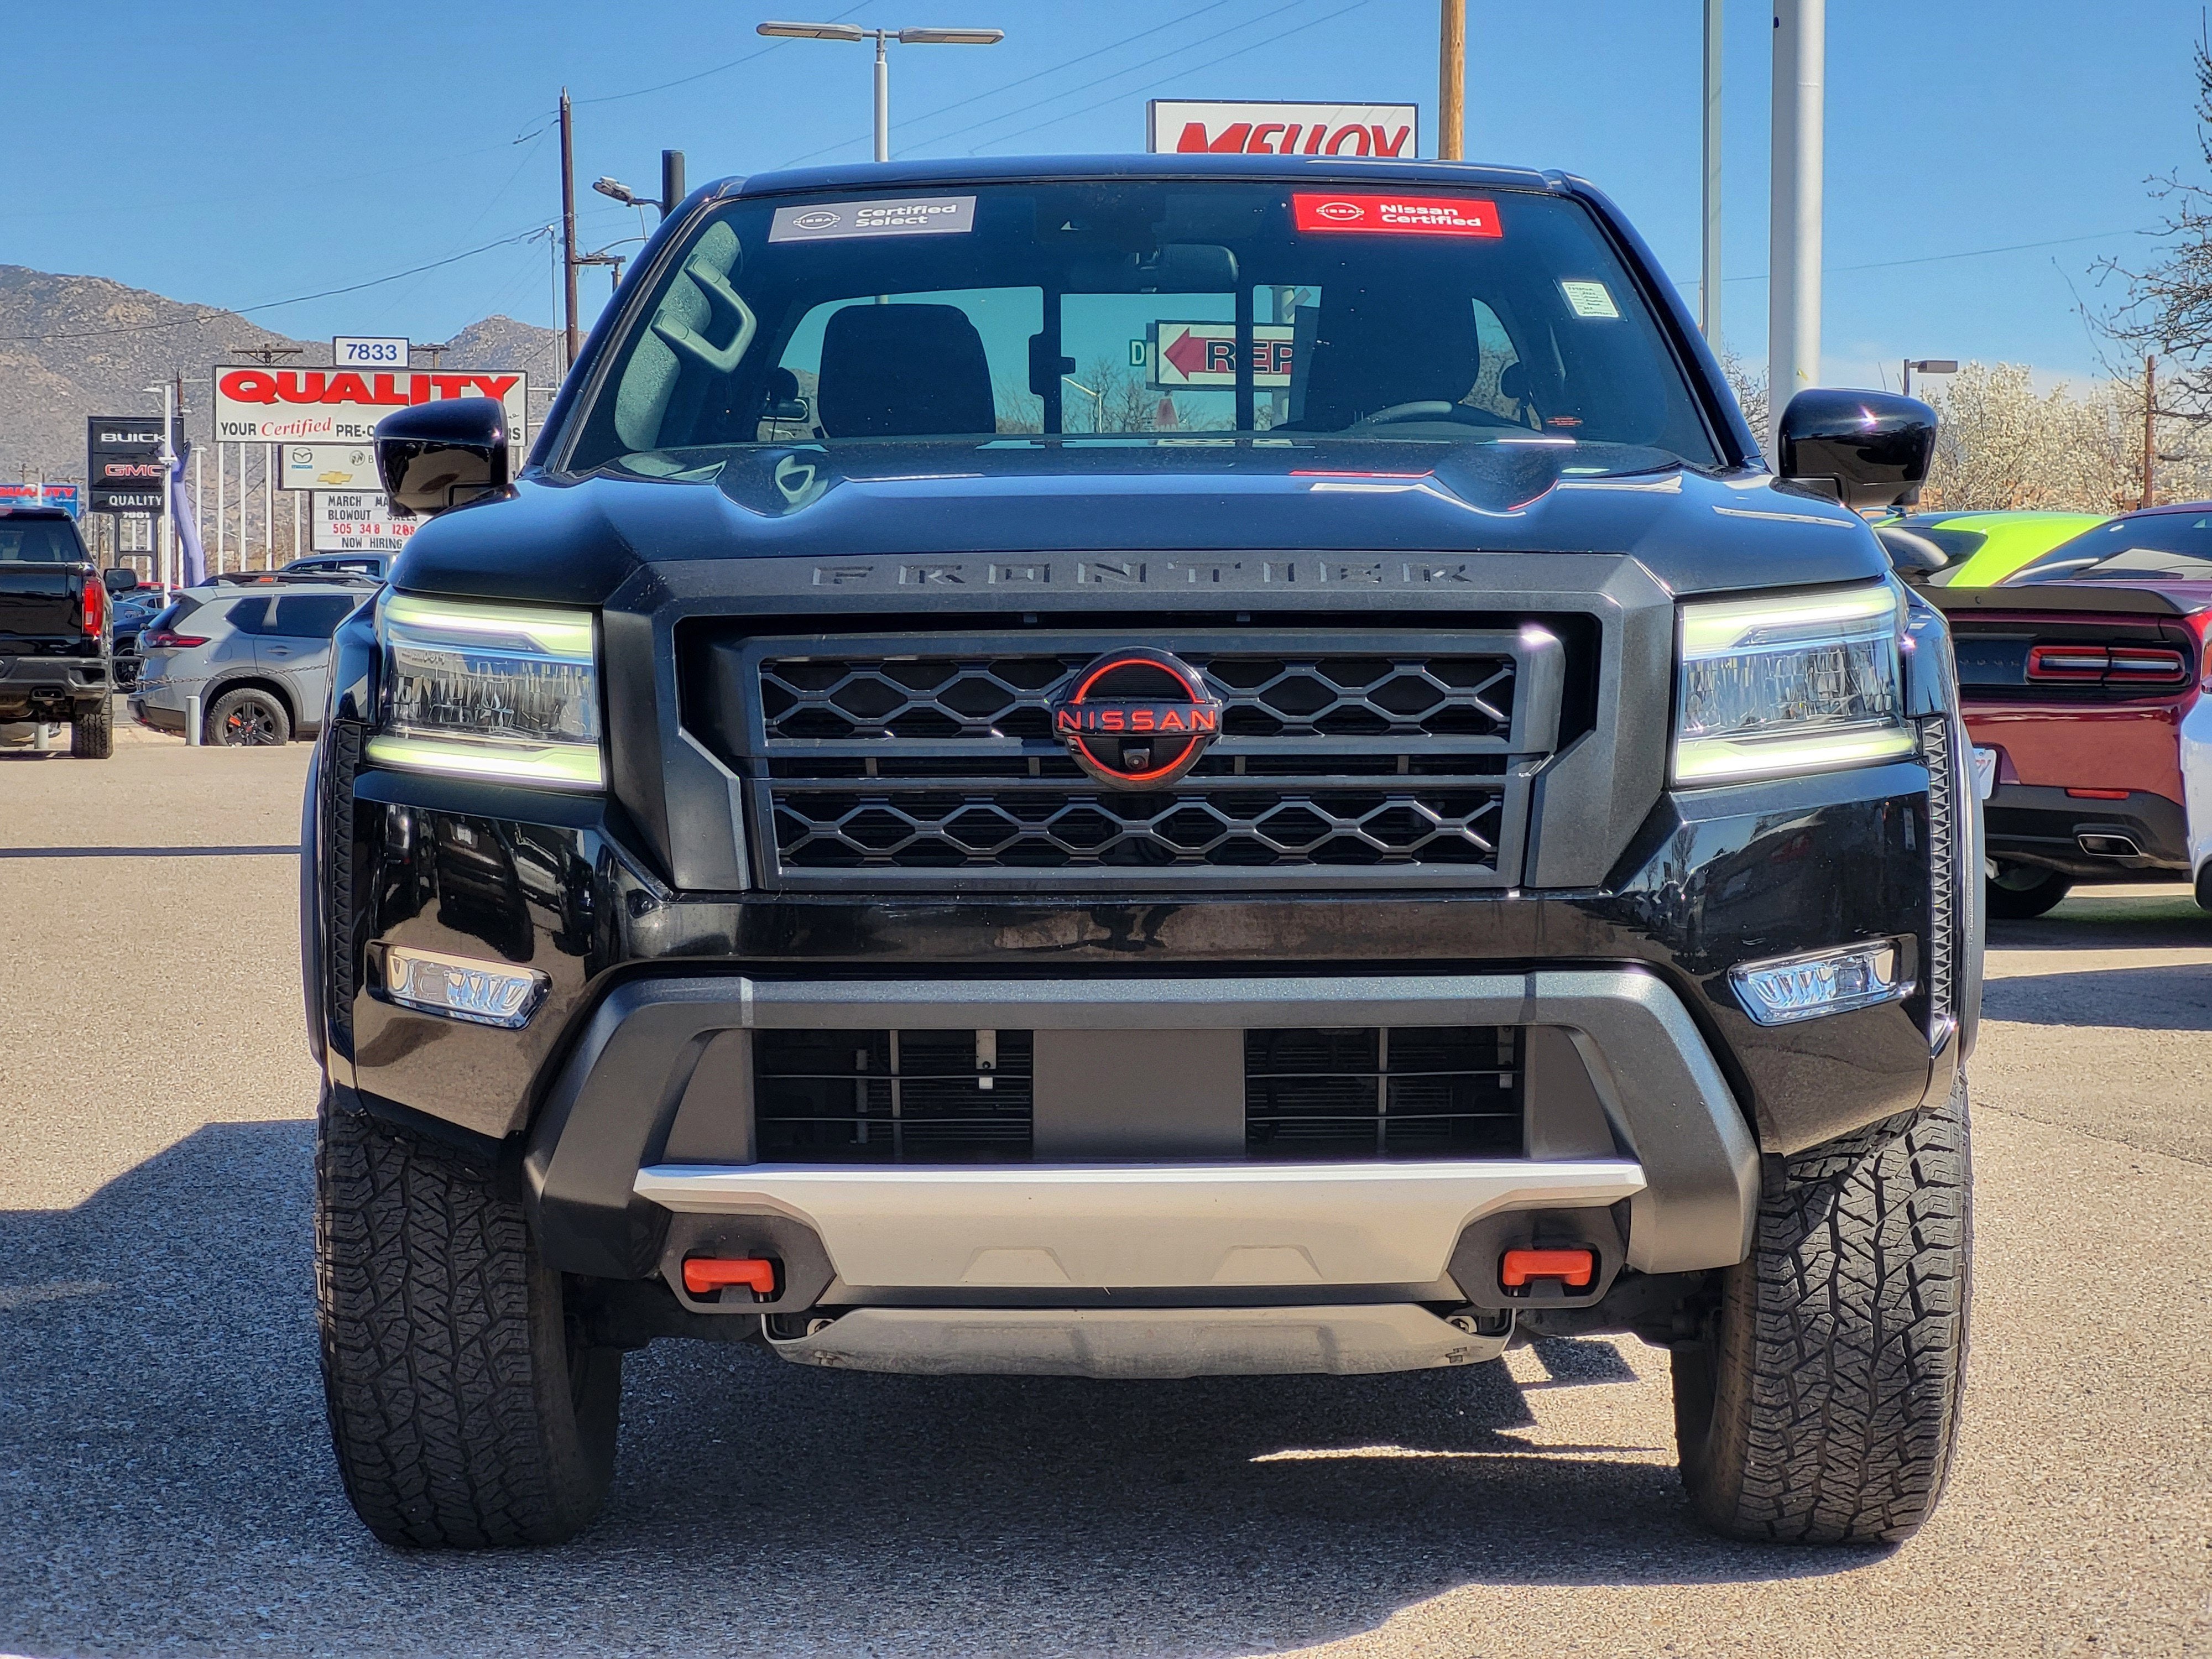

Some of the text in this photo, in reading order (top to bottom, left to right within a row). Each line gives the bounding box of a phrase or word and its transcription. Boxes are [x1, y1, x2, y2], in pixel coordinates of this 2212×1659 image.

[858, 205, 957, 217] Certified
[1380, 204, 1458, 216] Nissan
[855, 216, 929, 227] Select
[1381, 214, 1481, 227] Certified
[346, 343, 397, 360] 7833
[219, 369, 520, 406] QUALITY
[220, 422, 257, 436] YOUR
[262, 417, 332, 437] Certified
[101, 433, 165, 442] BUICK
[105, 464, 165, 477] GMC
[109, 495, 162, 505] QUALITY
[328, 495, 362, 507] MARCH
[328, 509, 372, 521] BLOWOUT
[333, 523, 352, 534] 505
[342, 537, 403, 549] NOW HIRING
[812, 562, 1472, 586] FRONTIER
[1057, 709, 1215, 731] NISSAN
